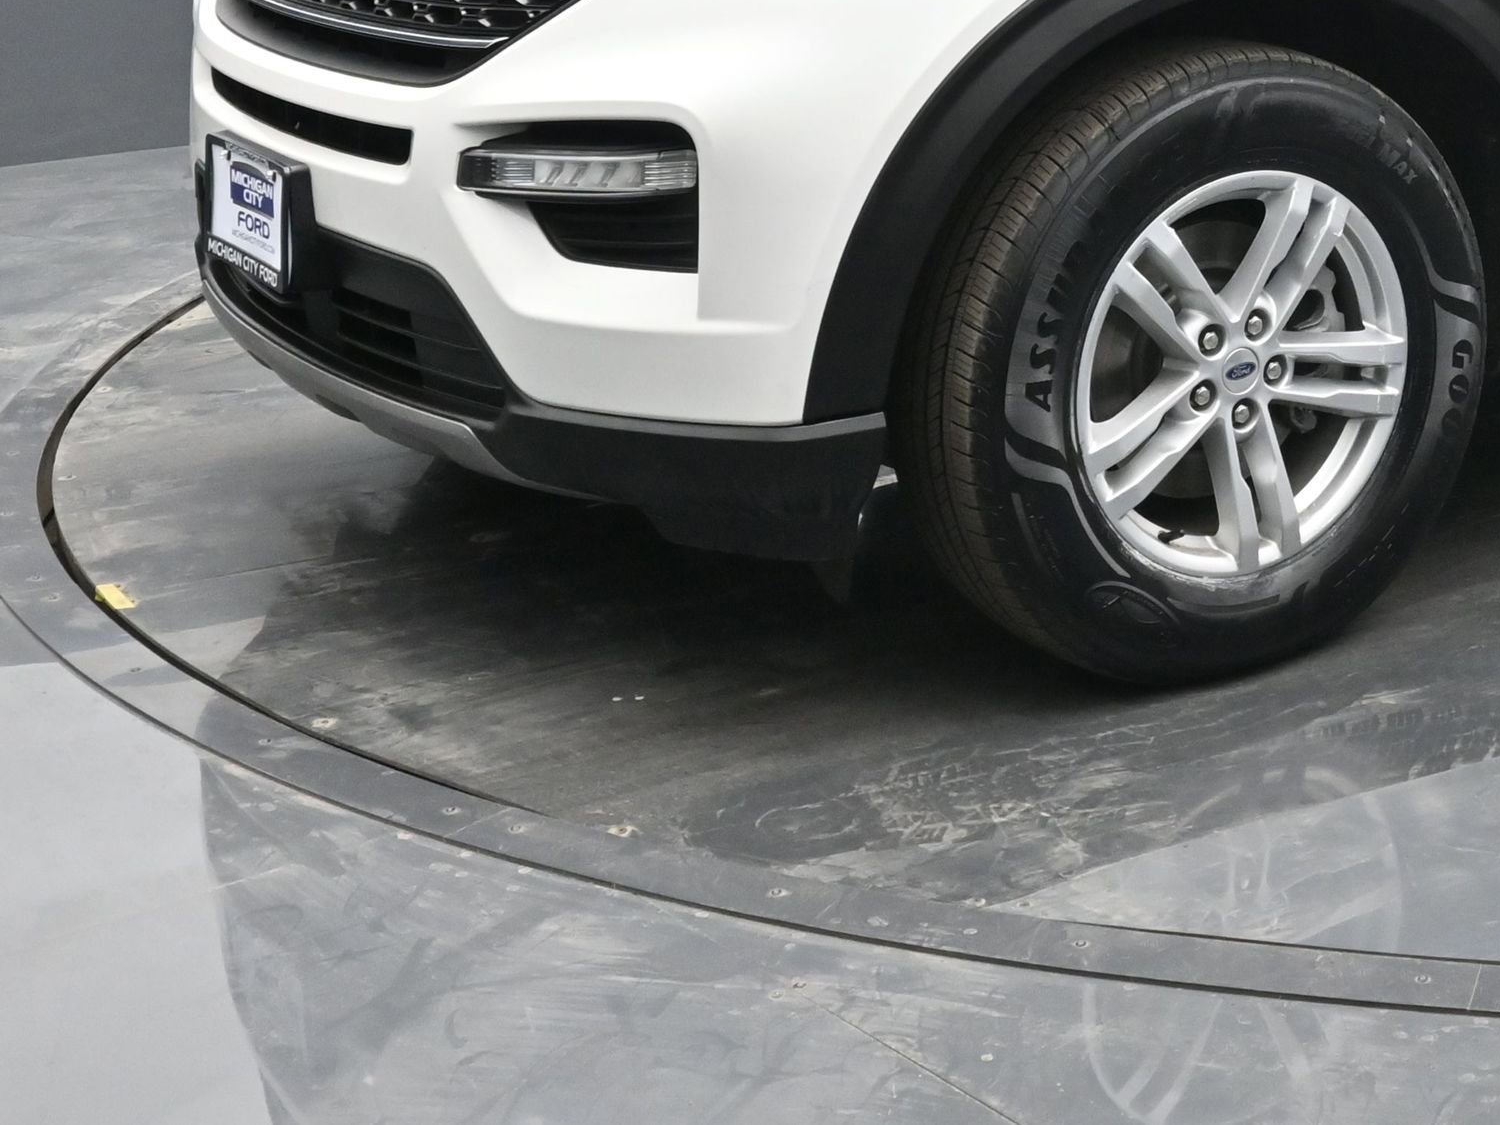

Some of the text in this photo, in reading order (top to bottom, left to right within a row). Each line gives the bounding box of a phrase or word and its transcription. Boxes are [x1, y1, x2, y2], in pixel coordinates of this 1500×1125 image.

[231, 169, 273, 200] MICHIGAN
[243, 190, 264, 209] CITY
[237, 210, 271, 240] FORD
[207, 238, 242, 267] MICHIGAN
[242, 257, 259, 276] CITY
[259, 265, 278, 287] FORD
